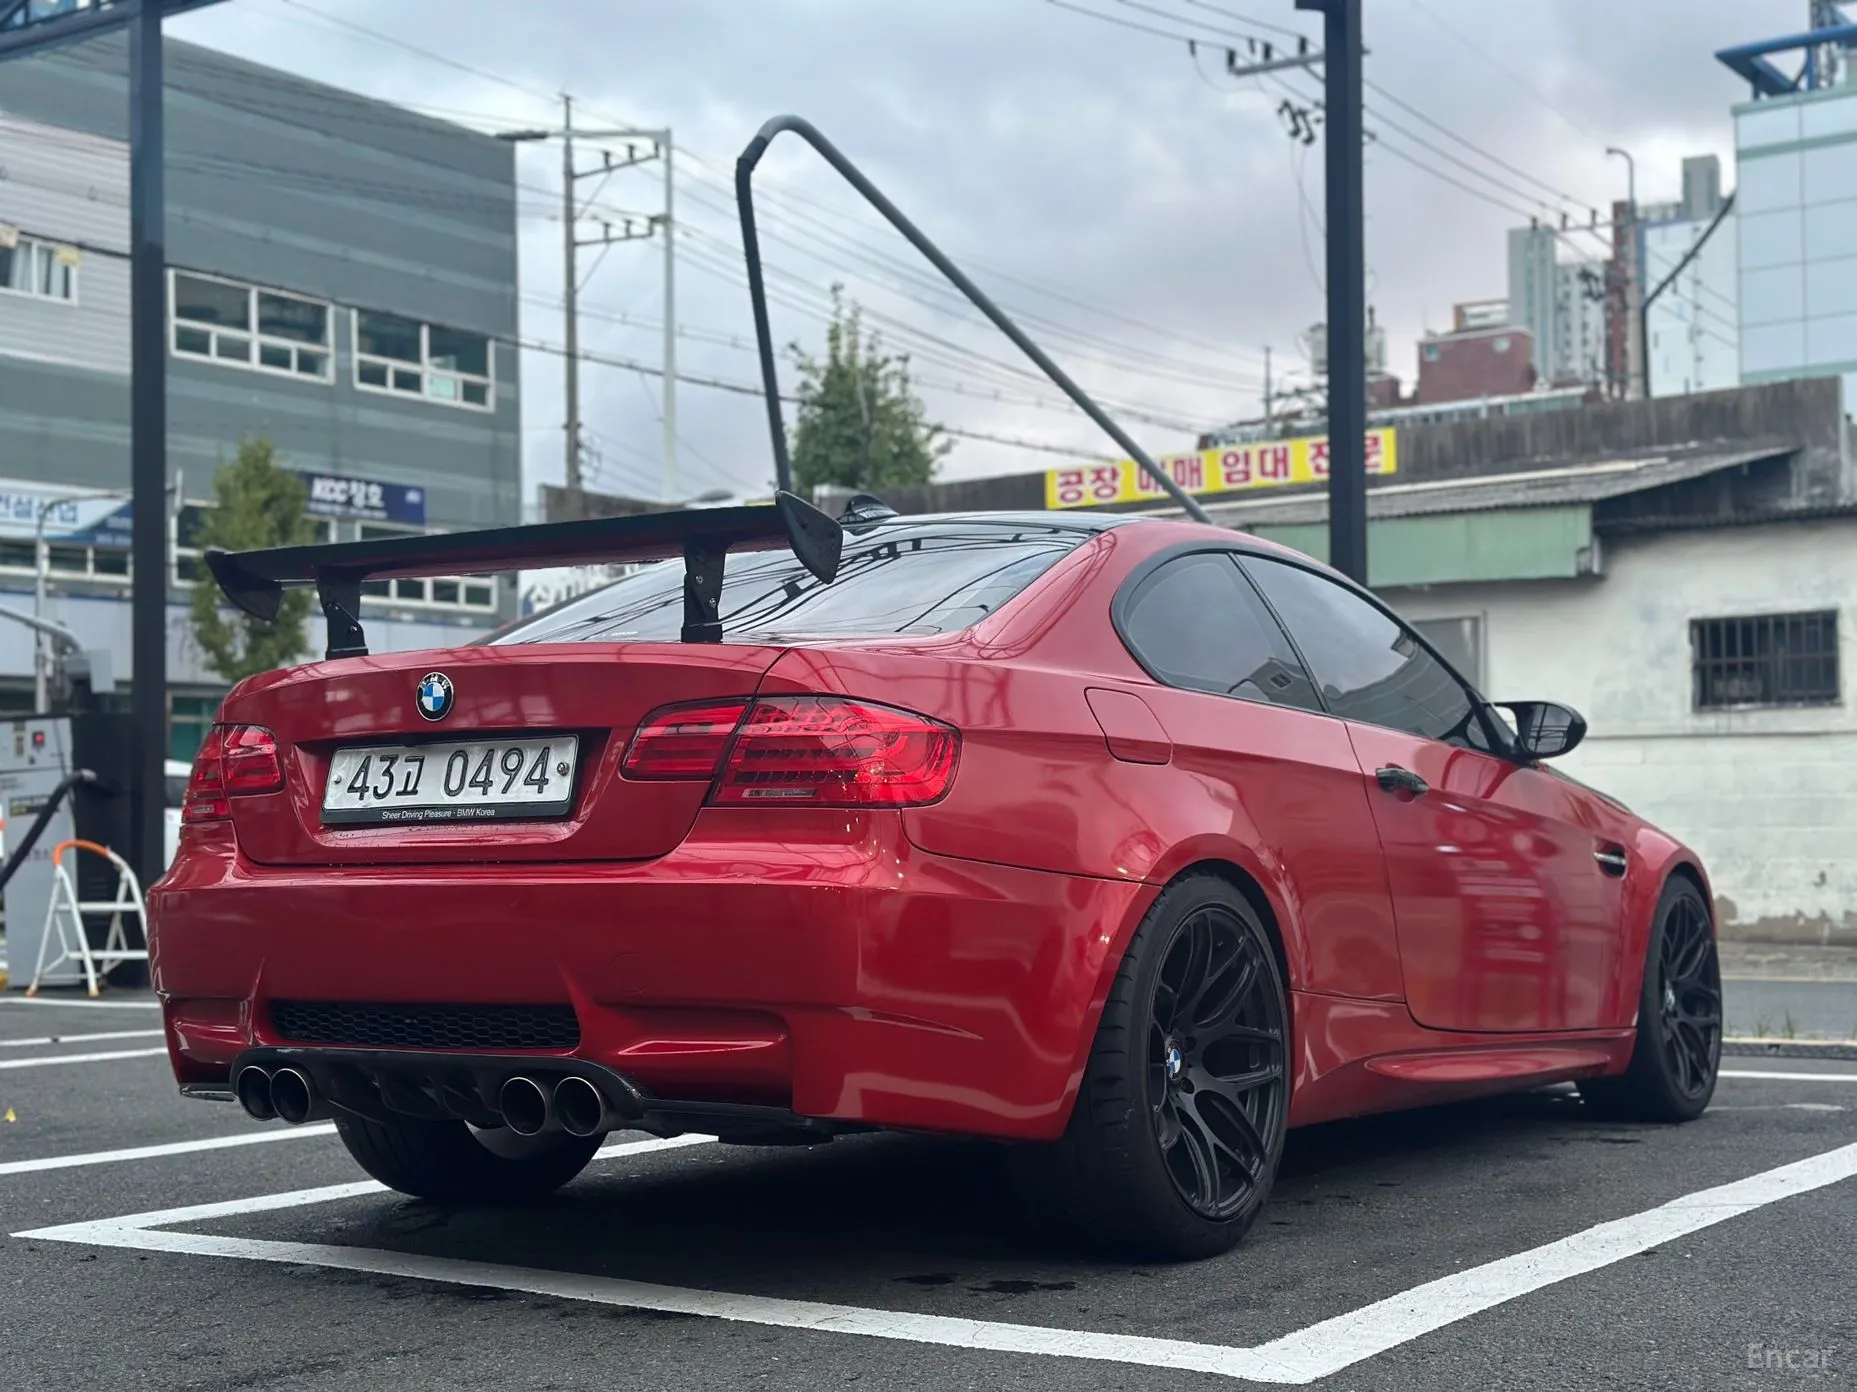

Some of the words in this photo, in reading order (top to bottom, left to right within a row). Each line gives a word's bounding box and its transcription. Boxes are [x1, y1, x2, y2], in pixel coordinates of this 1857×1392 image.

[1059, 467, 1119, 503] 공장
[1222, 446, 1288, 484] 임대
[347, 753, 426, 801] 43고
[443, 746, 550, 798] 0494
[381, 810, 401, 820] Sheer
[401, 809, 423, 820] Driving
[423, 809, 452, 819] Pleasure
[457, 807, 475, 817] BMW
[475, 807, 496, 817] Korea
